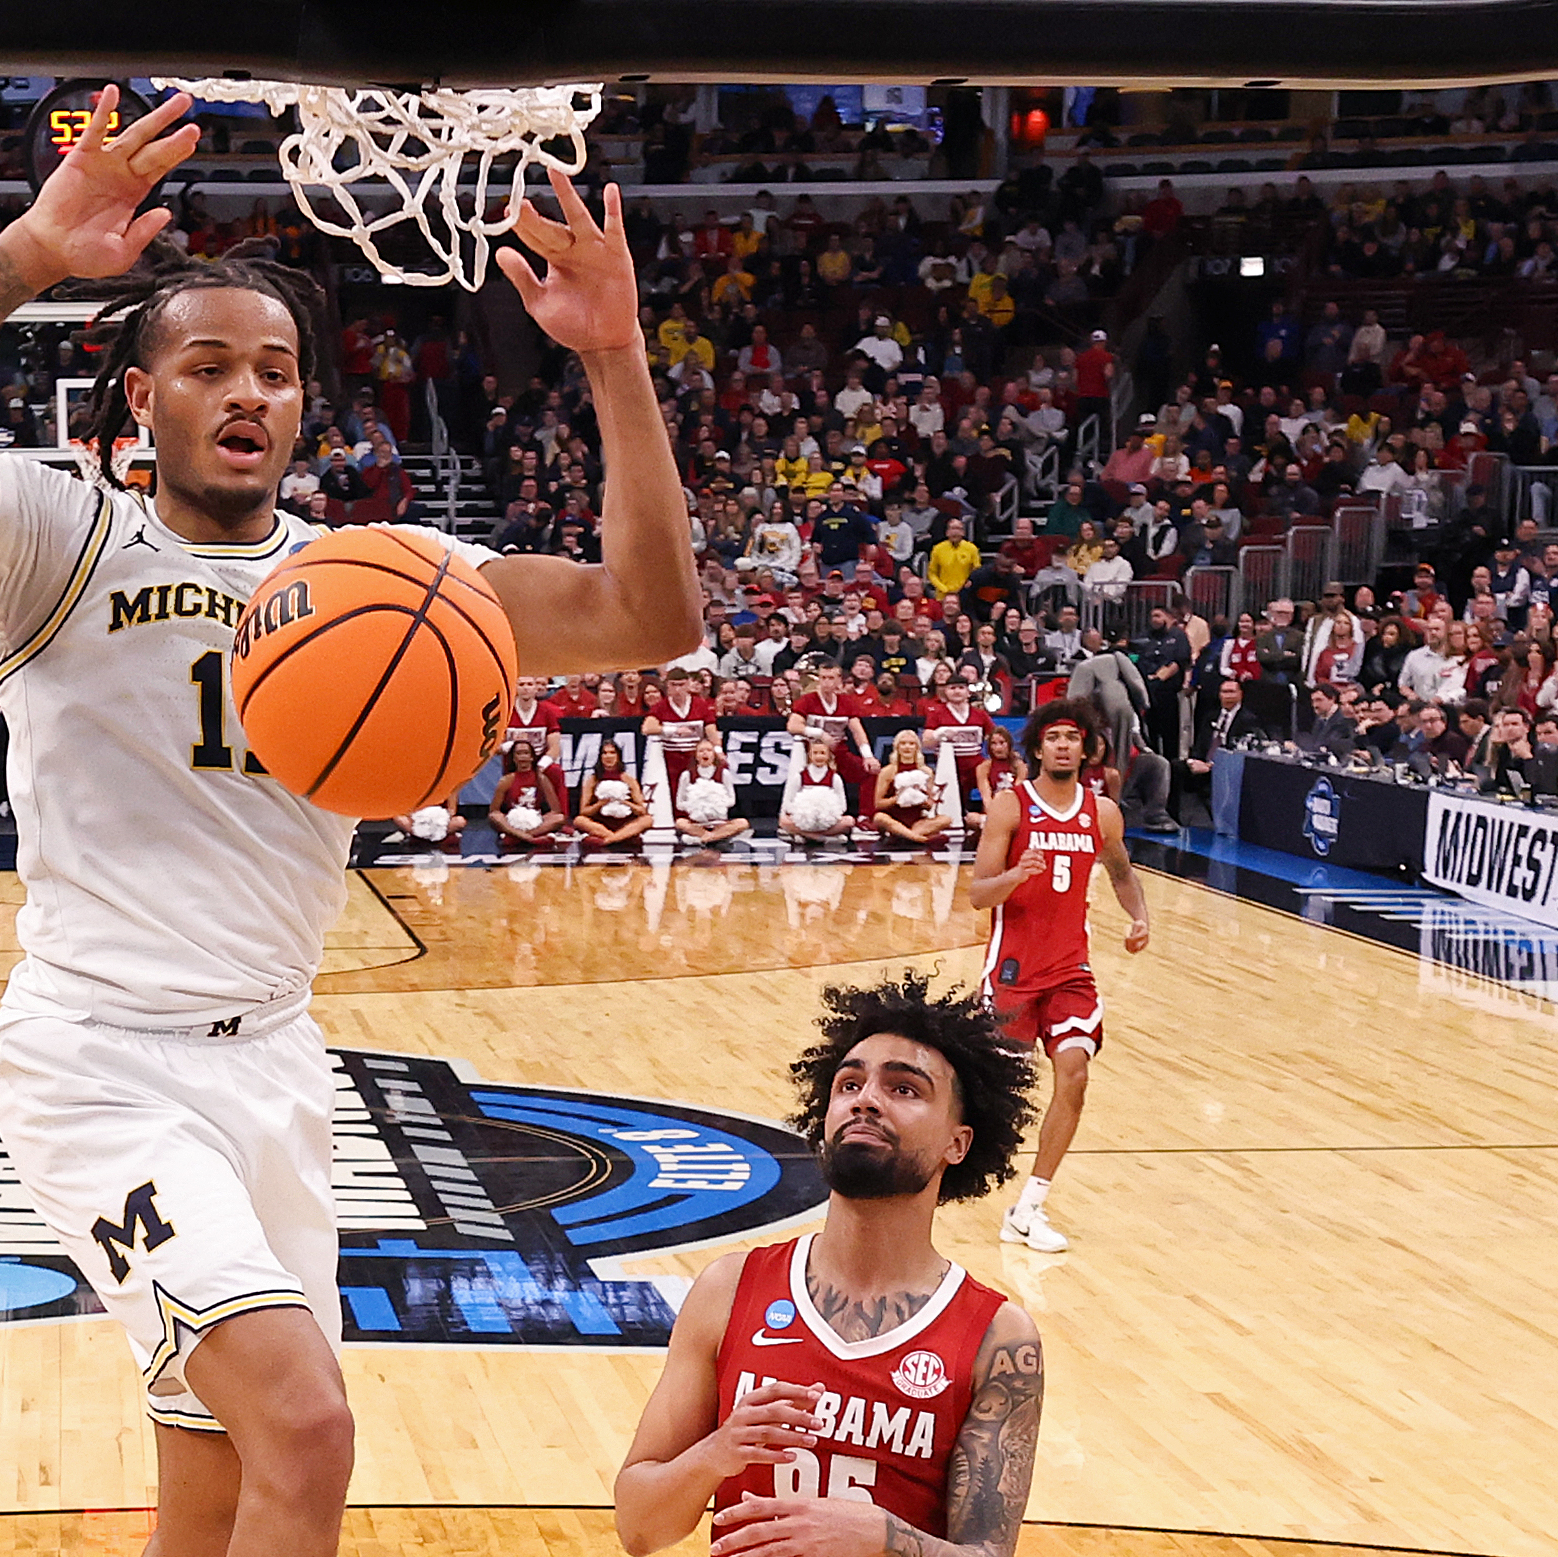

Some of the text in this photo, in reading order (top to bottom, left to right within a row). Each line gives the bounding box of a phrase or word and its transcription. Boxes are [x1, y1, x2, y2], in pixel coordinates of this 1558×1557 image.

[1029, 831, 1094, 853] ALABAMA
[1052, 855, 1071, 893] 5
[91, 1179, 178, 1286] M
[904, 1353, 941, 1387] SEC
[895, 1377, 943, 1398] GRADUATE
